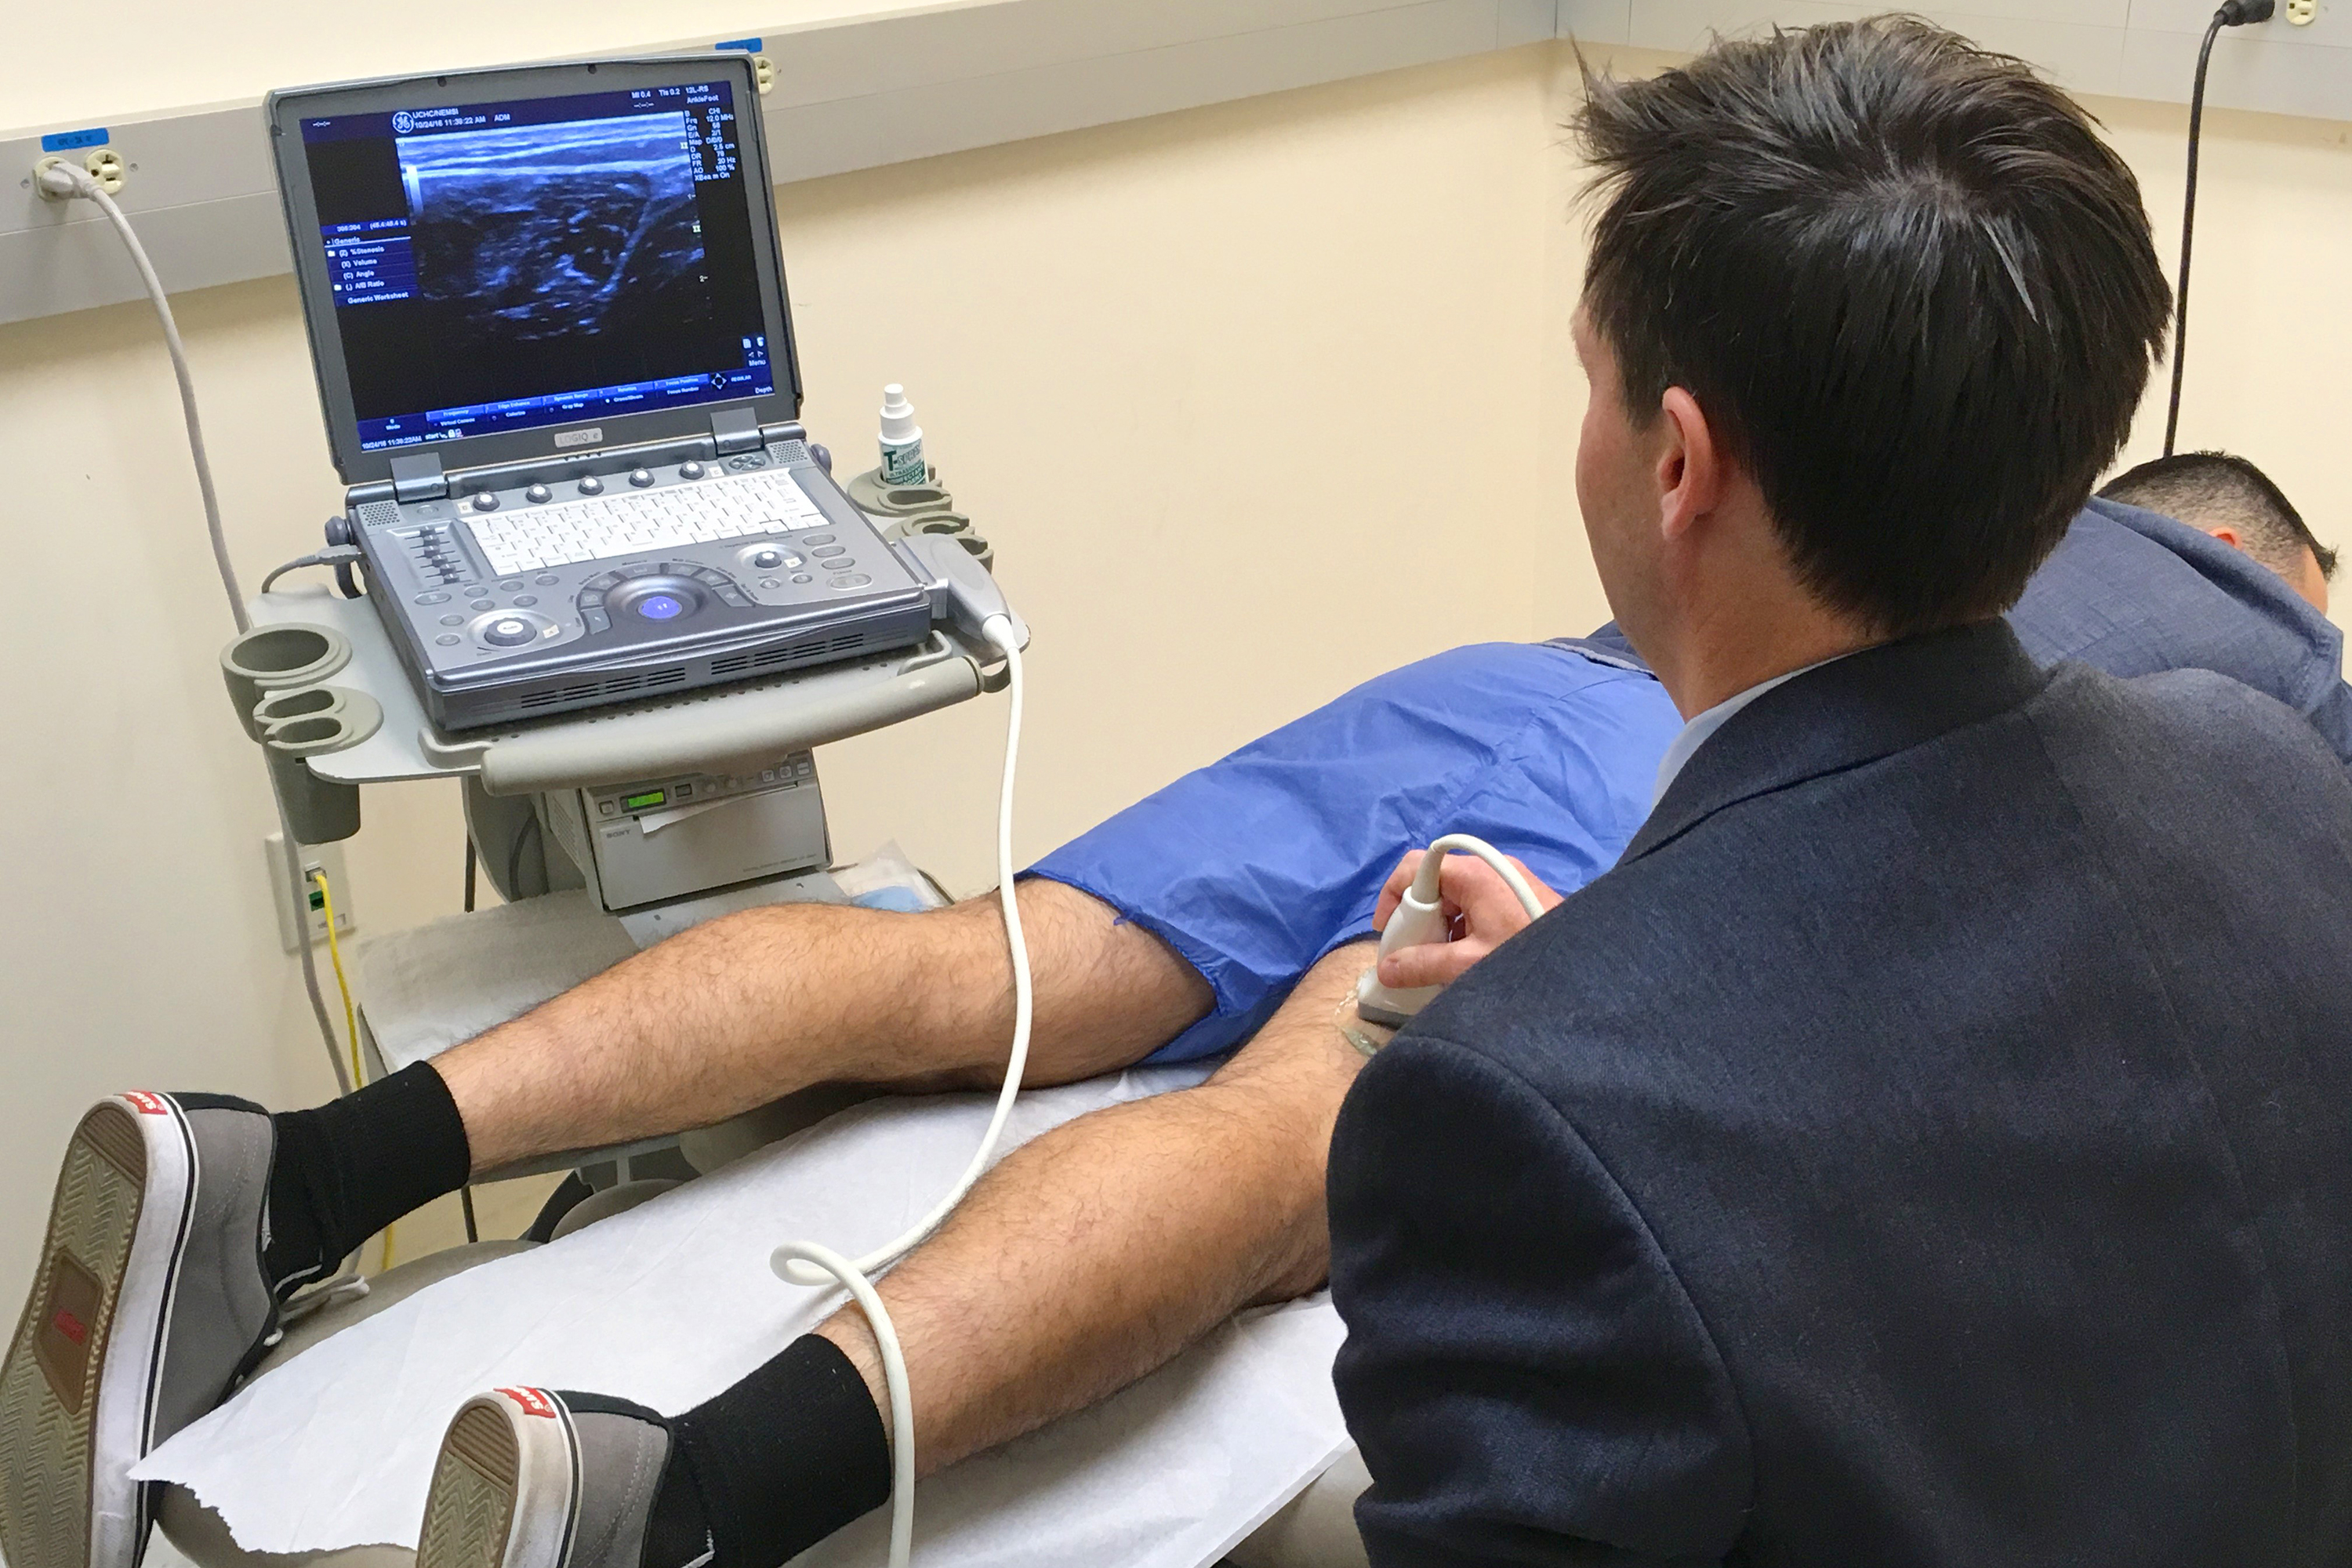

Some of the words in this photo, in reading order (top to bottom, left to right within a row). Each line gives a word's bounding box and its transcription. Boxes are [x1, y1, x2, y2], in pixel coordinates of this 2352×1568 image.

[347, 296, 373, 304] Generic
[373, 292, 408, 301] Worksheet
[755, 386, 773, 394] Depth
[560, 432, 588, 445] LOGIQ
